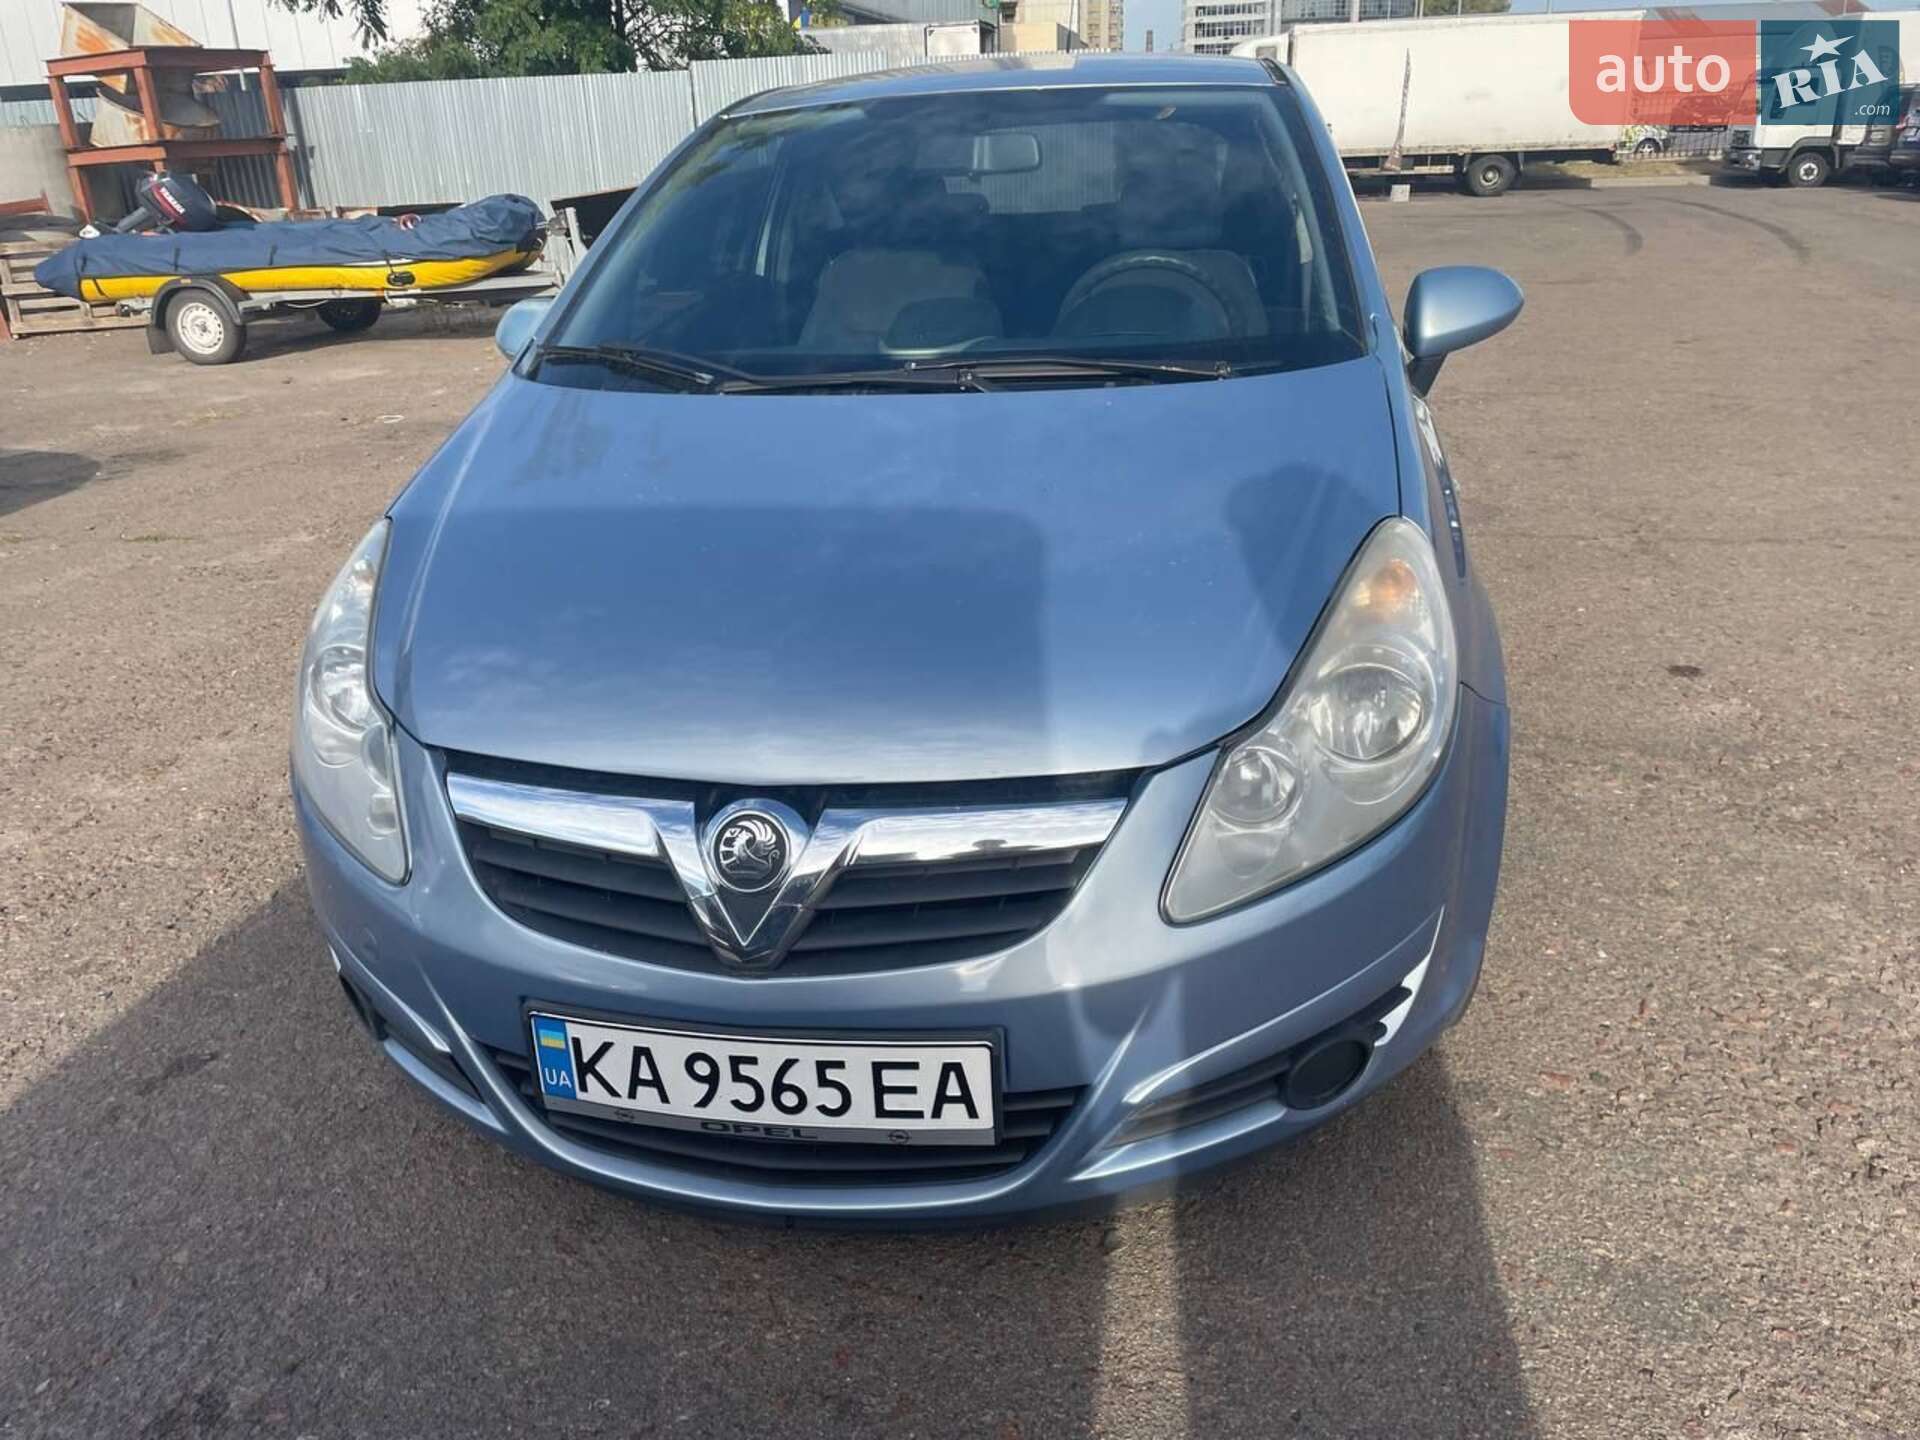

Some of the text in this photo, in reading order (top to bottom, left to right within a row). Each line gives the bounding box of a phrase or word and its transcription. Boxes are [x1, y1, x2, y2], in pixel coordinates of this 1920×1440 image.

[544, 1067, 573, 1089] UA
[571, 1036, 980, 1120] KA 9565 EA
[701, 1121, 818, 1140] OPEL
